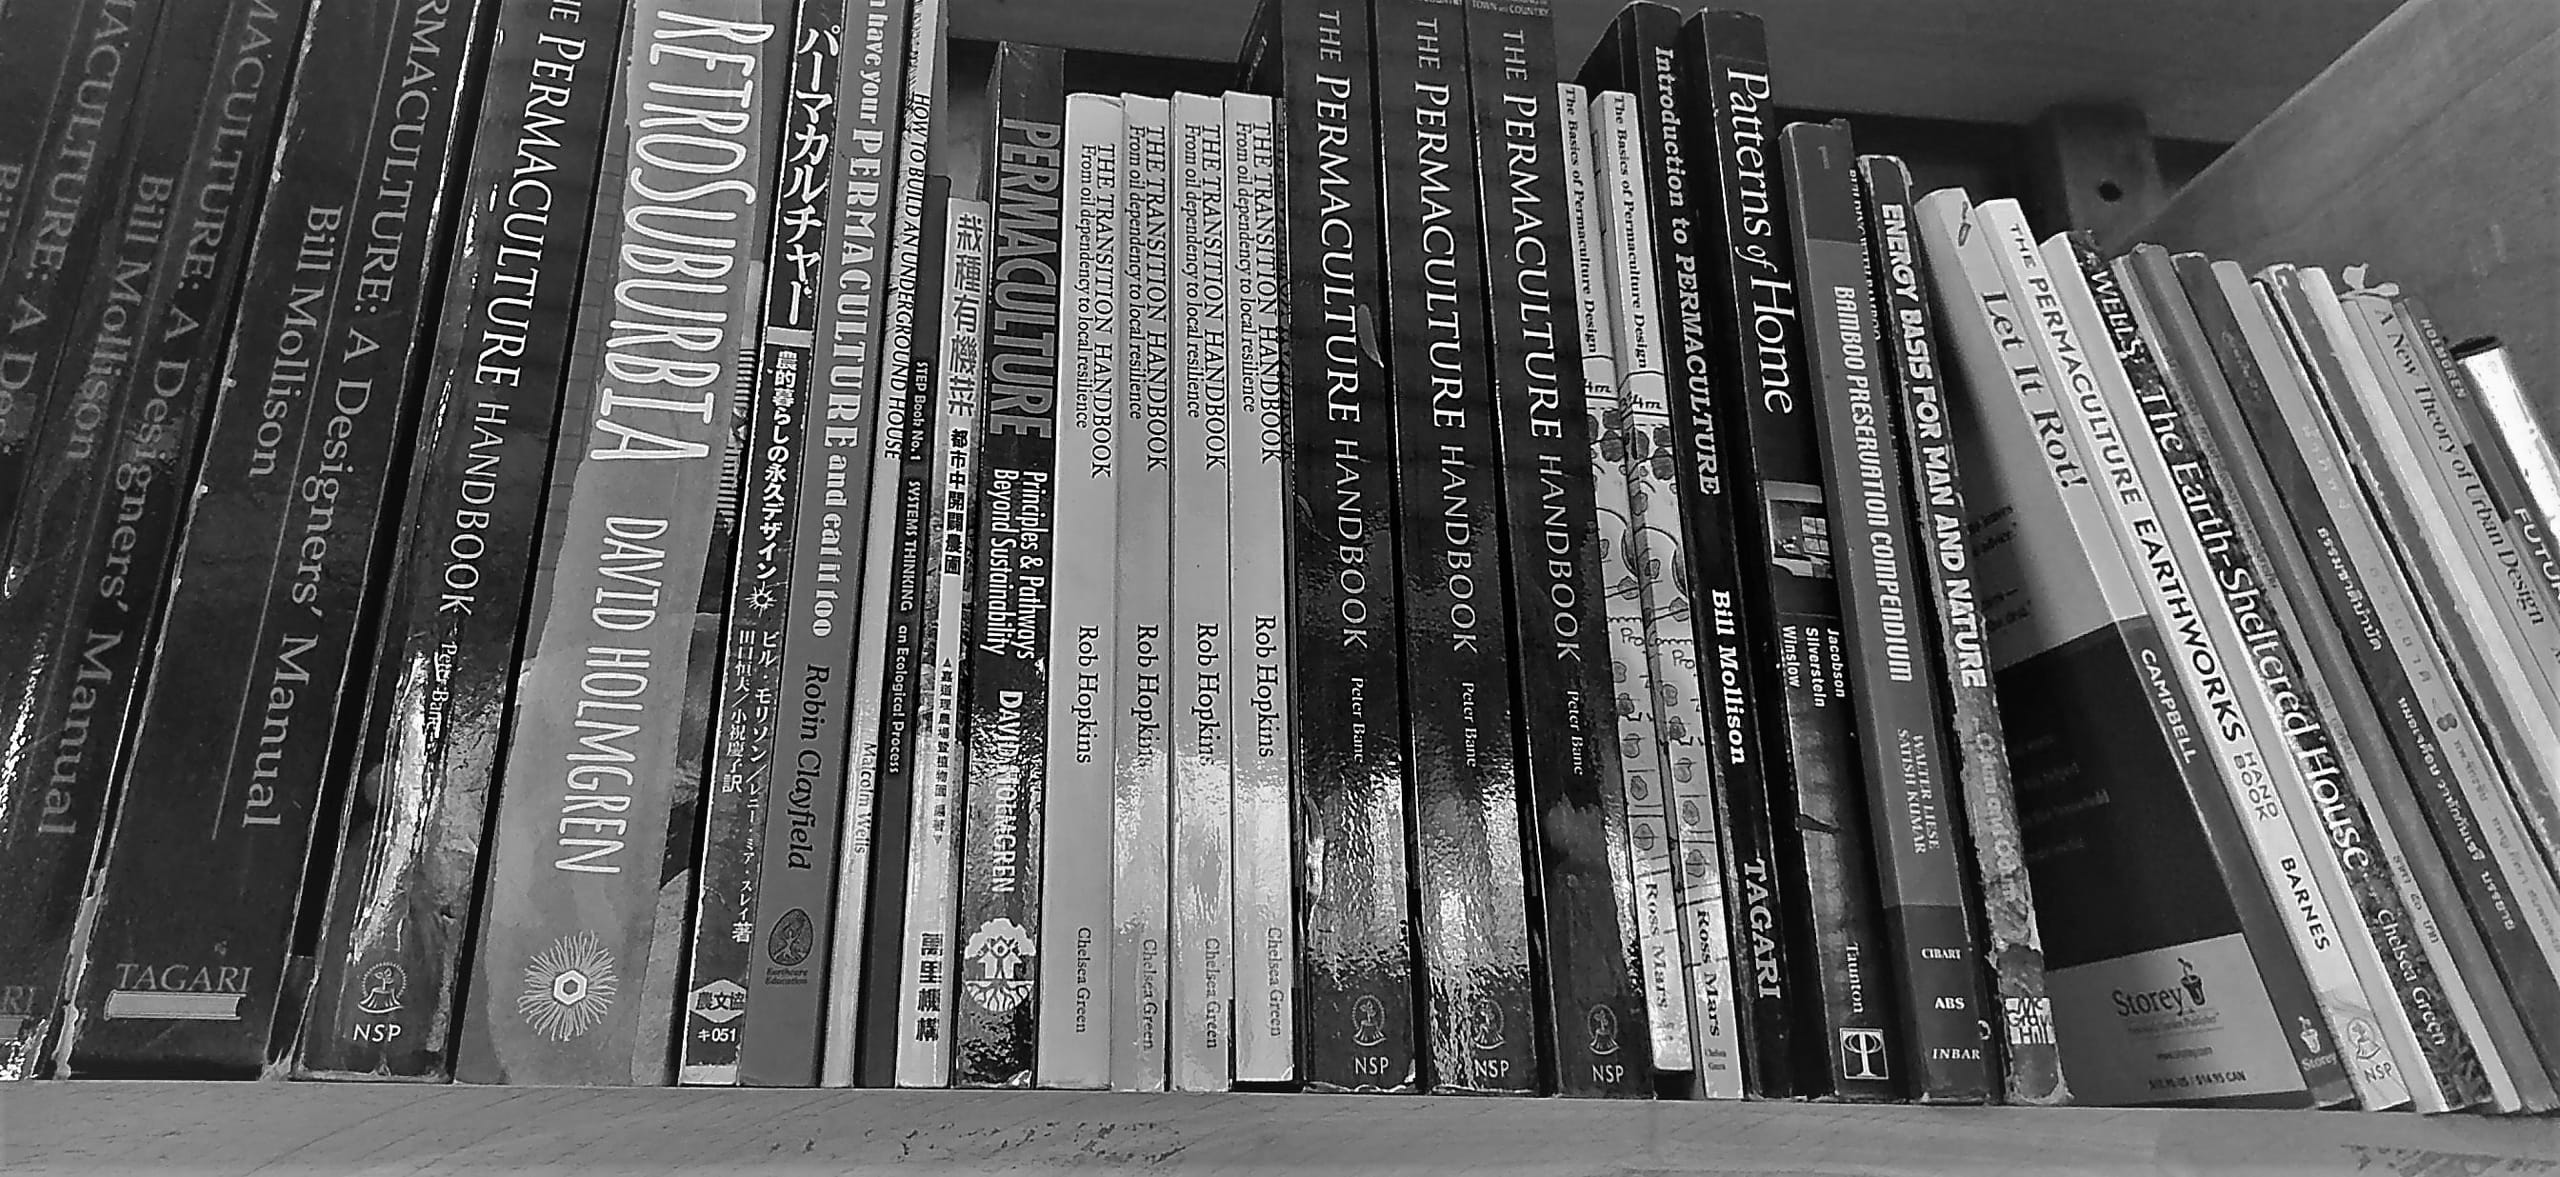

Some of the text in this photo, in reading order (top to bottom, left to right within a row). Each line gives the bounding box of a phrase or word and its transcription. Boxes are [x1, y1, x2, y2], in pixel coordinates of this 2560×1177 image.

[859, 66, 884, 125] your
[865, 13, 889, 64] have
[1503, 29, 1528, 81] THE
[590, 10, 775, 460] RETROSUBURBIA
[783, 25, 841, 326] パーマカルチャー
[1568, 120, 1597, 353] Basics Permaculture Design
[1727, 67, 1796, 414] Patterns of Home
[66, 174, 174, 459] Bill Mollison
[824, 129, 885, 448] PERMACULTURE
[885, 94, 930, 460] HOW BUILD UNDERGROUND HOUSE
[948, 213, 983, 417] 栽種有機菜
[990, 118, 1061, 438] PERMACULTURE
[1074, 144, 1095, 428] From dependency local resilience
[1092, 144, 1115, 478] THE TRANSITION HANDBOOK
[1146, 126, 1168, 472] THE TRANSITION HANDBOOK
[1202, 125, 1225, 470] THE TRANSITION HANDBOOK
[1253, 121, 1281, 464] THE TRANSITION HANDBOOK
[1503, 93, 1563, 439] PERMACULTURE
[1617, 129, 1646, 369] Basics Permaculture Design
[1656, 46, 1720, 496] Introduction to PERMACULTURE
[248, 205, 343, 477] Bill Mollison
[440, 33, 585, 616] PERMACULTURE HANDBOOK
[1315, 9, 1367, 649] THE PERMACULTURE HANDBOOK
[1414, 18, 1479, 654] THE PERMACULTURE HANDBOOK
[1834, 286, 1865, 370] BAMBOO
[1979, 291, 2089, 488] Let It Rot!
[2420, 319, 2467, 399] HOLMGREN
[756, 351, 798, 580] 農的暮らしの永久デザイン
[825, 454, 848, 507] and
[909, 362, 929, 461] STEP No.1
[1847, 374, 1888, 527] PRESERVATION
[1881, 204, 1987, 689] ENERGY BASIS FOR MAN AND NATURE
[2389, 332, 2544, 626] New Theory of Urban Design
[2010, 224, 2245, 742] THE PERMACULTURE EARTHWORKS
[242, 328, 380, 828] A Designers' Manual
[888, 481, 921, 775] SYSTEMS THINKING Ecological Process
[980, 469, 1019, 655] Beyond Sustainability
[1010, 471, 1048, 659] Principles Pathways
[1538, 454, 1582, 663] HANDBOOK
[1870, 532, 1913, 682] COMPENDIUM
[2141, 389, 2184, 452] The
[2172, 461, 2321, 737] Earth-Sheltered
[2300, 746, 2369, 870] House
[554, 516, 669, 873] DAVID HOLMGREN
[1071, 625, 1099, 764] Rob Hopkins
[1137, 624, 1159, 667] Rob
[1197, 623, 1219, 666] Rob
[1251, 615, 1279, 757] Rob Hopkins
[1461, 682, 1475, 723] Peter
[1566, 690, 1581, 732] Peter
[1712, 589, 1745, 765] Bill Mollison
[1782, 626, 1800, 688] Winslow
[1806, 627, 1825, 708] Silverstein
[1827, 629, 1844, 697] Jacobson
[2141, 648, 2198, 765] CAMPBELL
[38, 629, 124, 836] Manual
[788, 664, 831, 869] Robin Clayfield
[1898, 728, 1927, 854] SATISH KUMAR
[1913, 735, 1940, 850] WALTER LIESE
[2233, 754, 2270, 821] BOOK
[2243, 751, 2279, 819] HAND
[1697, 910, 1712, 964] Ross
[1744, 857, 1780, 999] TAGARI
[2281, 856, 2331, 951] BARNES
[116, 963, 252, 991] TAGARI
[352, 1023, 402, 1043] NSP
[1076, 927, 1092, 1033] Chelsea Green
[1704, 971, 1720, 1037] Mars
[1845, 942, 1863, 1013] Taunton
[1934, 998, 1965, 1010] ABS
[2112, 987, 2183, 1017] Storey
[2378, 909, 2446, 1046] Chelsea Green
[1355, 1056, 1389, 1075] NSP
[1474, 1059, 1509, 1078] NSP
[1592, 1064, 1624, 1083] NSP
[1932, 1048, 1980, 1060] INBAR
[2226, 1070, 2248, 1083] CAN
[2302, 1053, 2337, 1072] Storey
[2364, 1062, 2392, 1084] NSP
